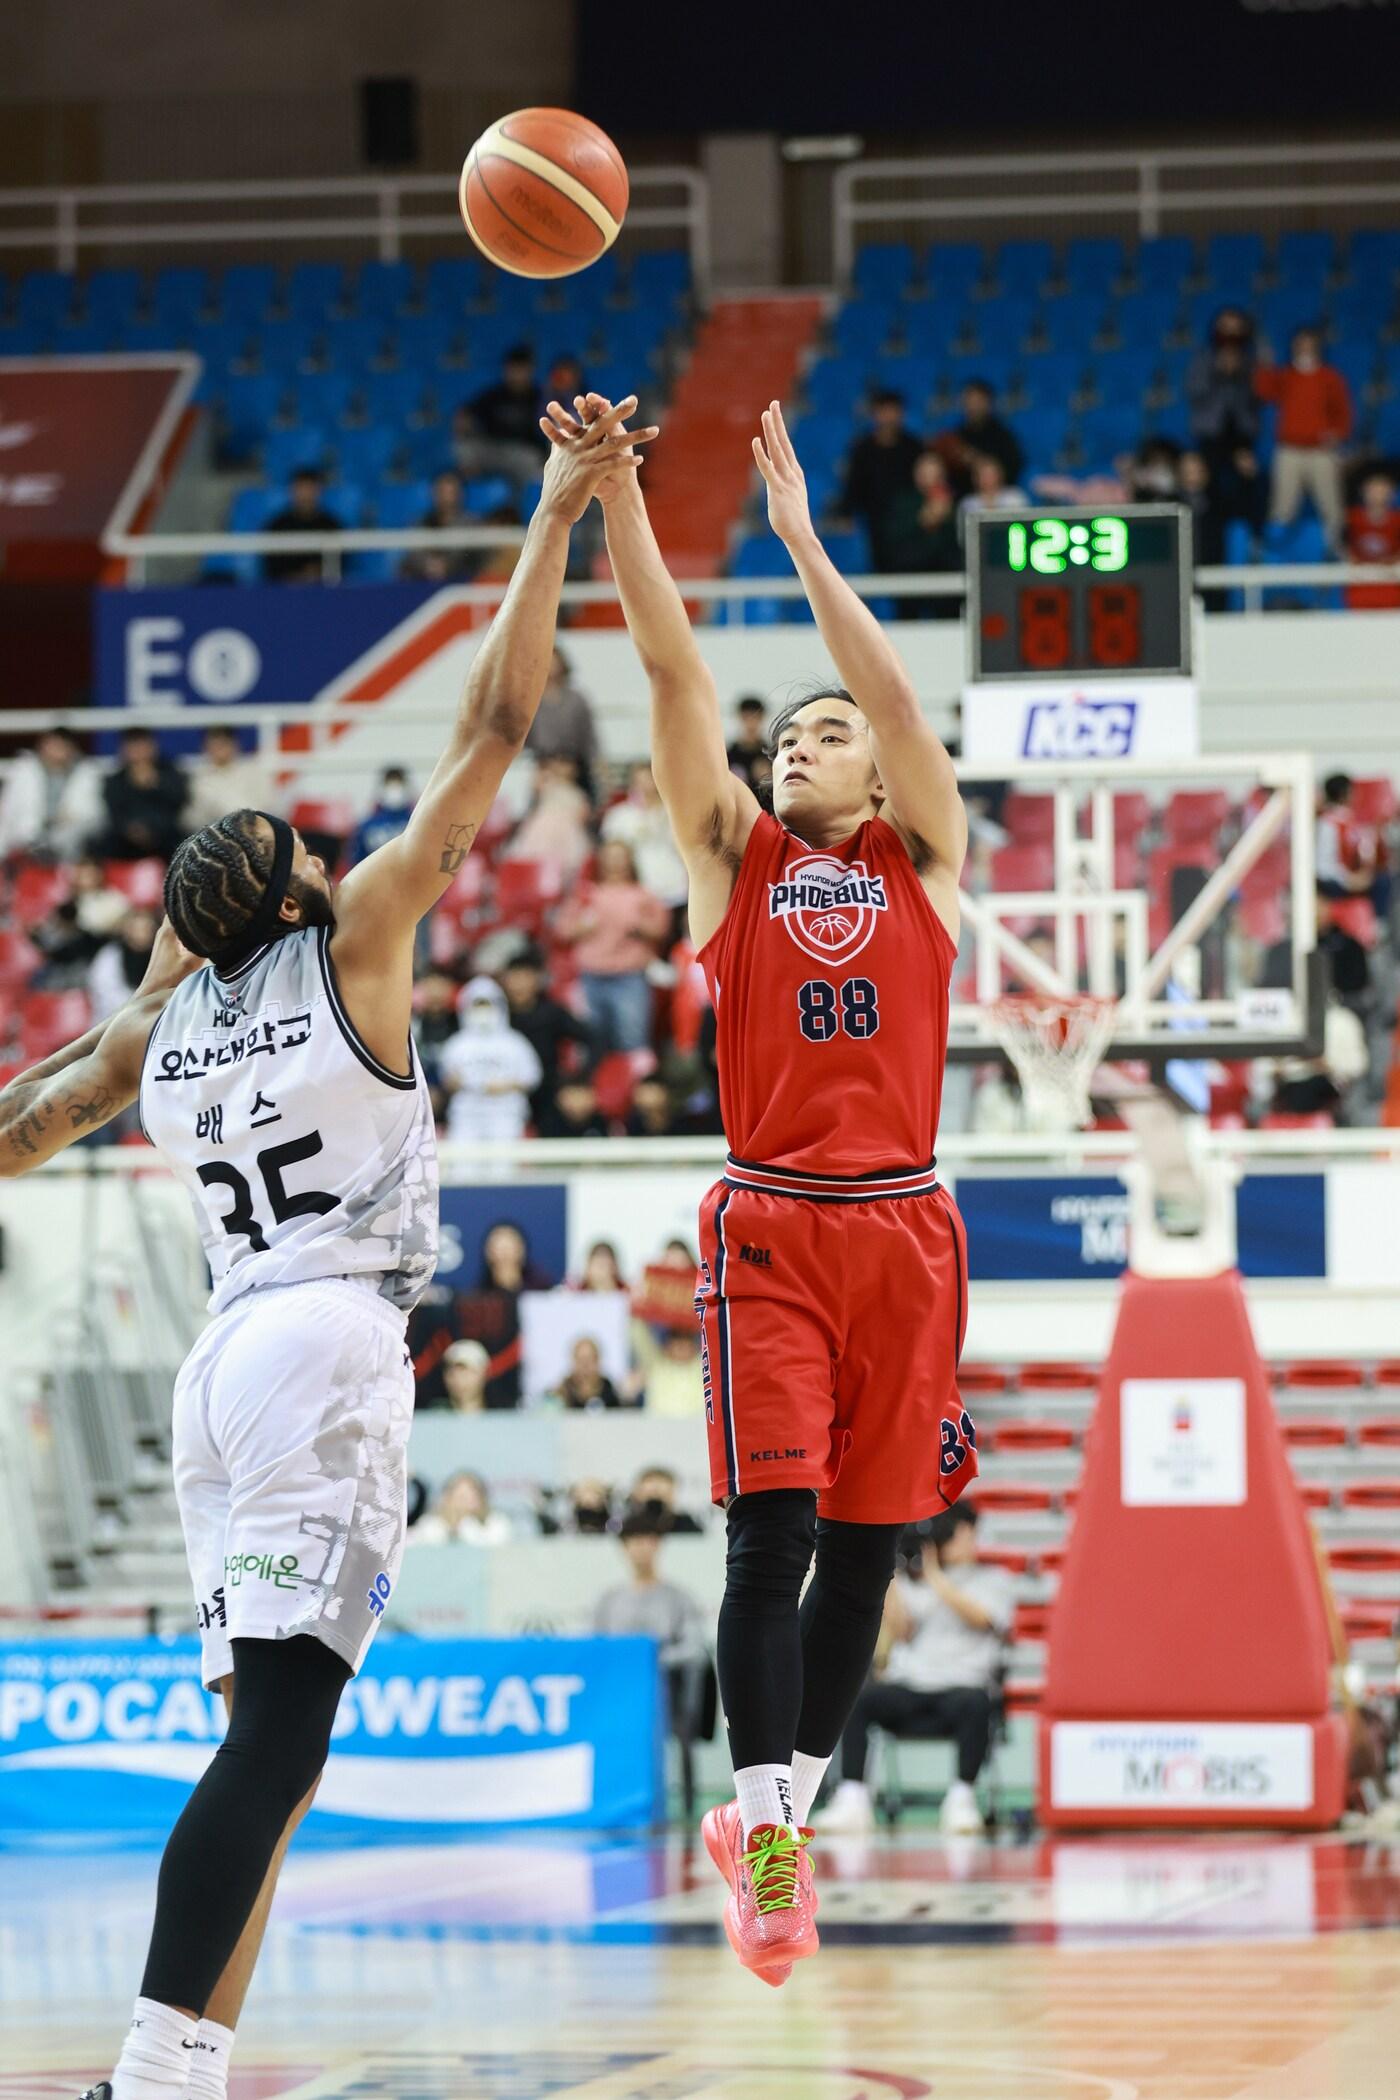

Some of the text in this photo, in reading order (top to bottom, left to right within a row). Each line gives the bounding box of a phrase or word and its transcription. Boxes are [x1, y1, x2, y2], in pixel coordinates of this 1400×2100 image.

[1022, 701, 1137, 760] KCC
[771, 878, 887, 914] PHOEBUS
[797, 977, 880, 1043] 88
[154, 1012, 312, 1082] 오산대학교
[196, 1129, 341, 1253] 35
[751, 1449, 807, 1462] KELME
[0, 1679, 230, 1741] POCA
[1124, 1754, 1272, 1797] MOBIS
